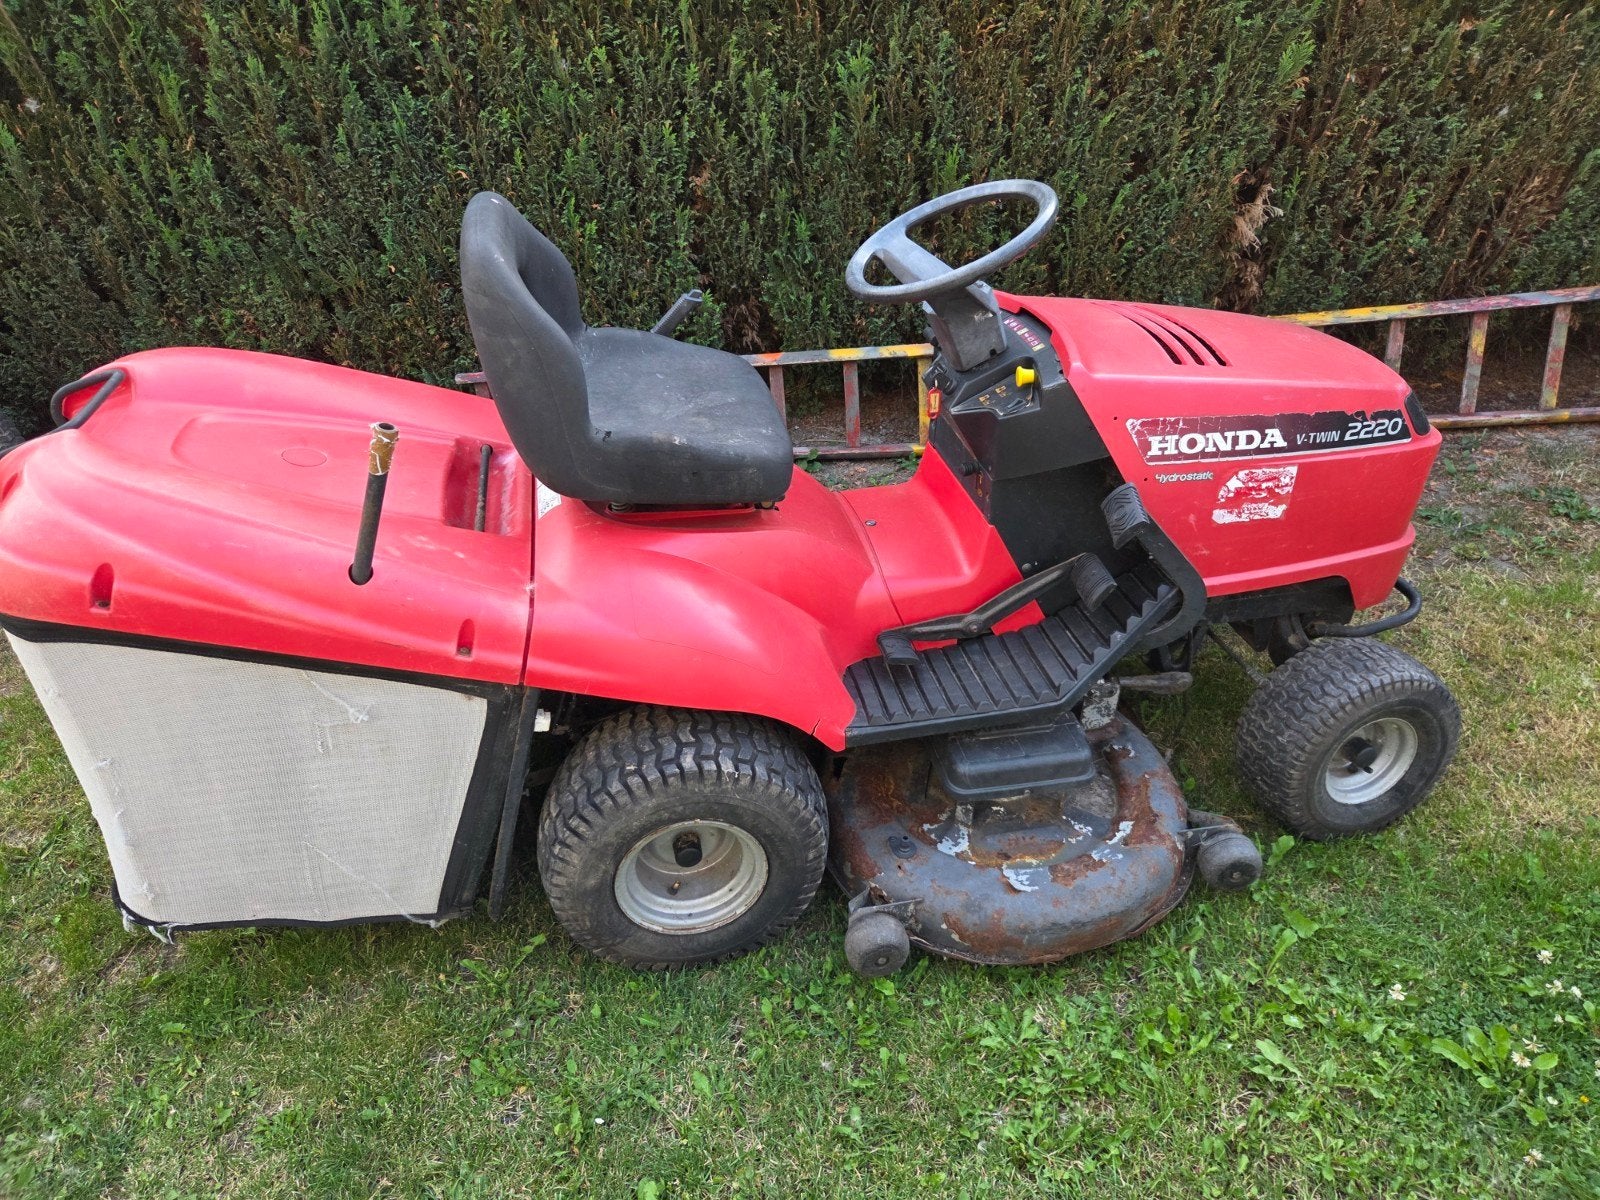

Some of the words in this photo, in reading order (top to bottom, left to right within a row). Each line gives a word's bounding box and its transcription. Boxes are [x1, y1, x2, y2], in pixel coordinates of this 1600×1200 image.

[1147, 428, 1287, 456] HONDA
[1296, 430, 1340, 445] V-TWIN
[1344, 417, 1403, 441] 2220
